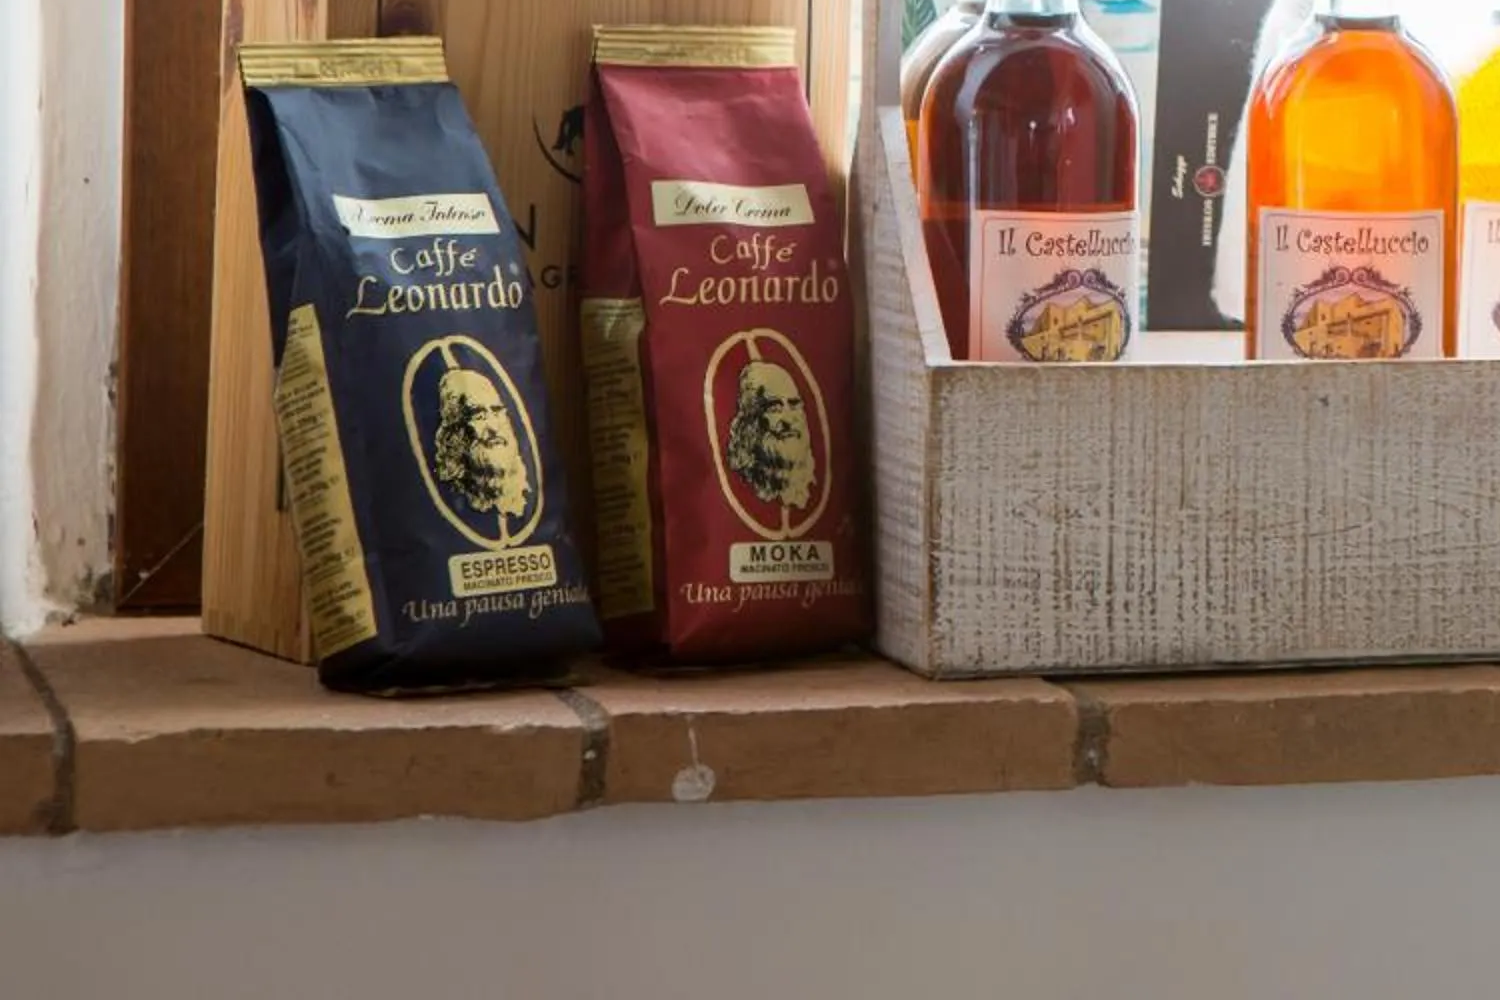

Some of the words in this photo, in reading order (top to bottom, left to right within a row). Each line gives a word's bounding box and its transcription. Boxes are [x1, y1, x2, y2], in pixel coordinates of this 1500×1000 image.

[998, 227, 1017, 257] Il
[1275, 224, 1289, 252] Il
[1296, 226, 1430, 256] Castelluccio
[345, 263, 524, 320] Leonardo
[658, 258, 840, 306] Leonardo
[460, 551, 551, 580] ESPRESSO
[750, 543, 821, 563] MOKA
[402, 597, 458, 623] Una
[459, 590, 526, 628] pausa
[680, 581, 732, 605] Una
[732, 581, 799, 613] pausa
